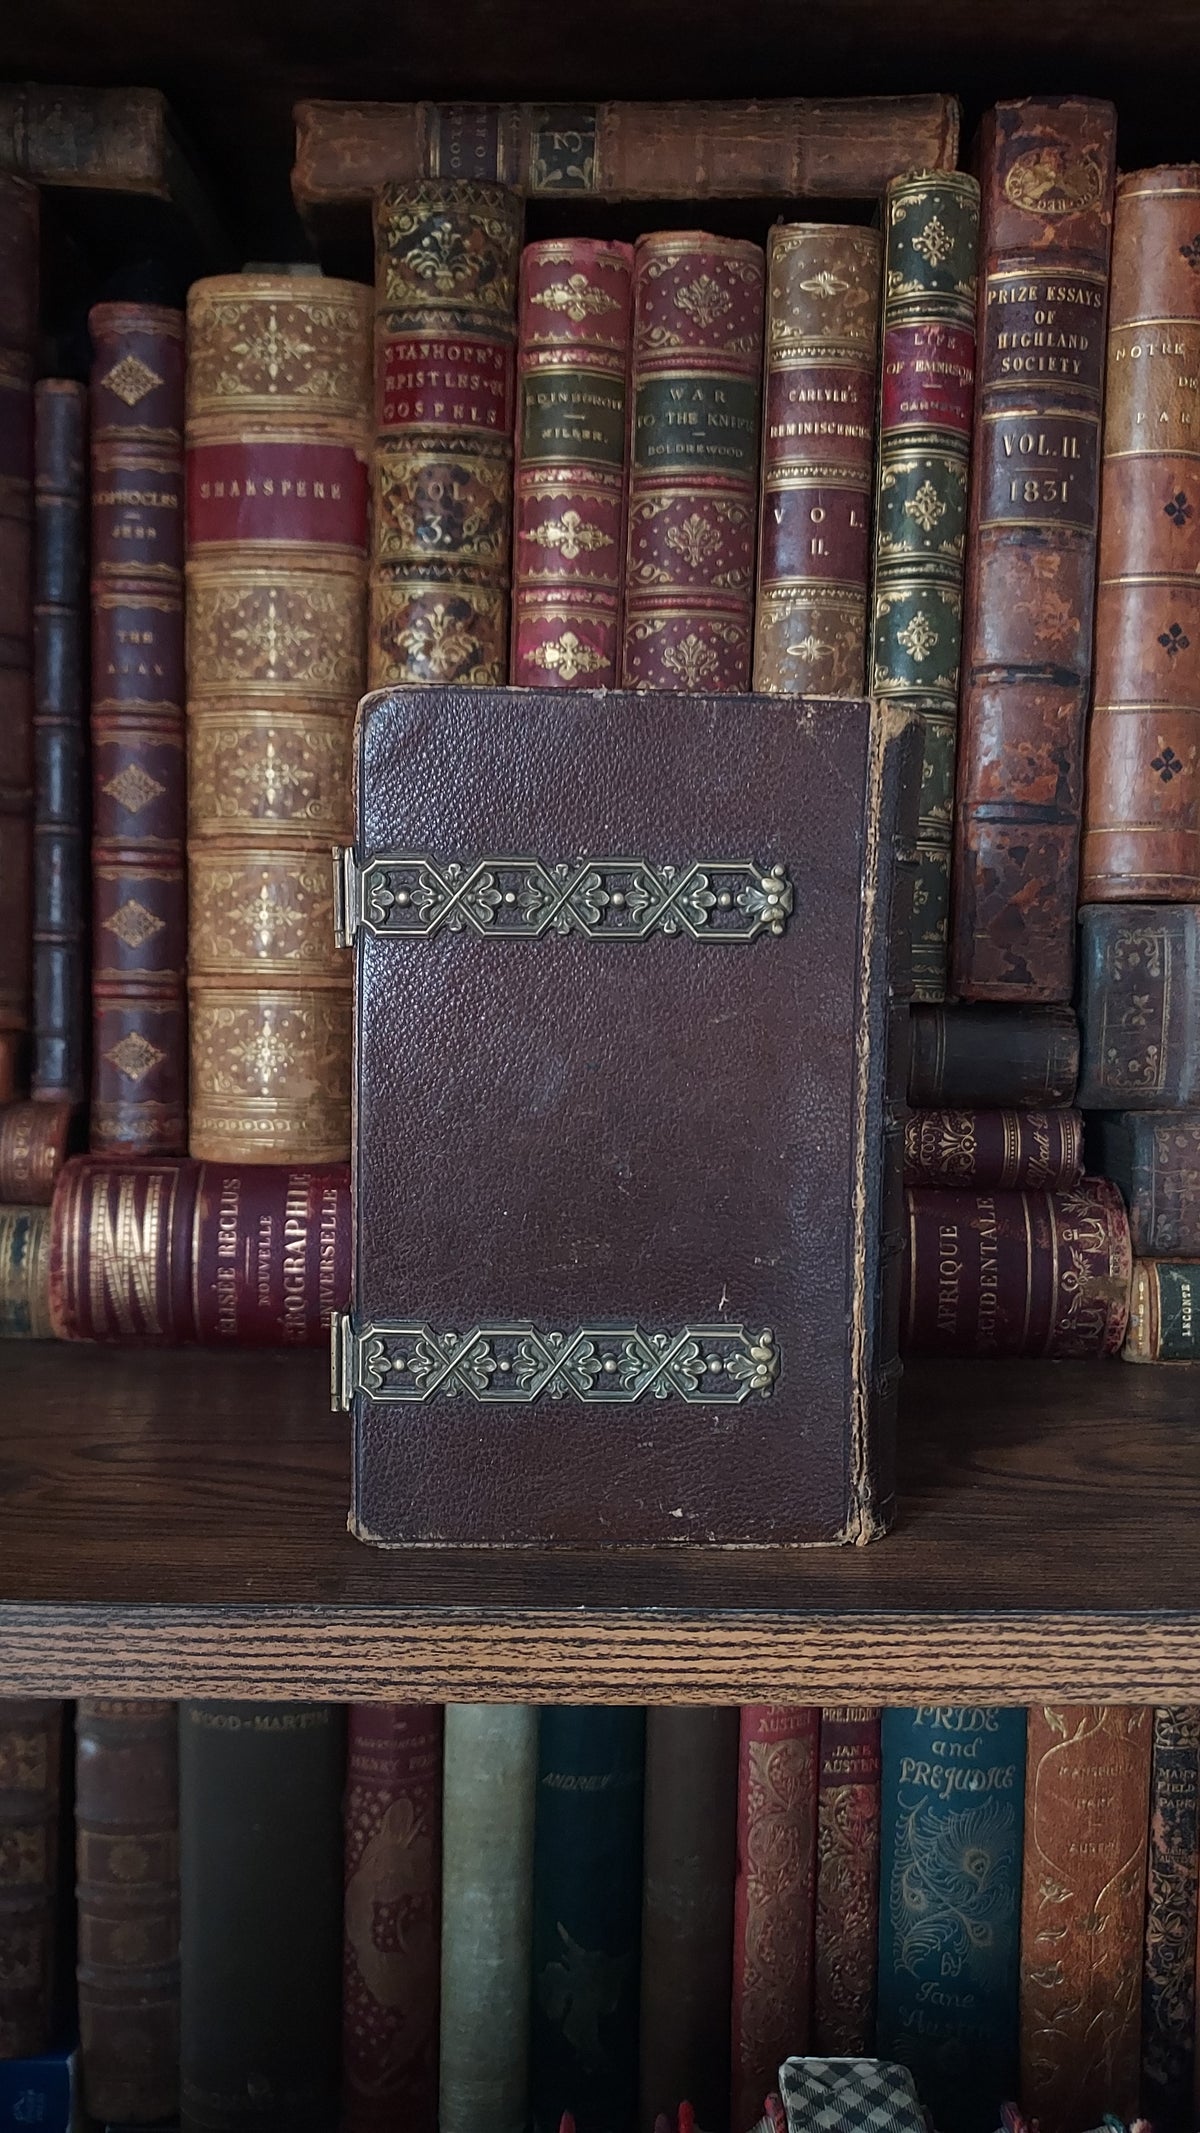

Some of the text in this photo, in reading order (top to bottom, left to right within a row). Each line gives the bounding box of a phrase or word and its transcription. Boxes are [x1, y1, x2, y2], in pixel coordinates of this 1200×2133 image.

[987, 286, 1102, 308] PRIZE ESSAYS
[1034, 310, 1057, 325] OF
[997, 331, 1089, 351] HIGHLAND
[1116, 343, 1185, 360] NOTRE
[886, 361, 905, 374] OF
[1001, 356, 1082, 375] SOCIETY
[669, 388, 727, 404] WAR
[788, 385, 858, 403] CARLYLE'S
[665, 410, 698, 427] THE
[647, 443, 743, 459] BOLDREWOOD
[1010, 479, 1068, 503] 1831
[217, 1178, 241, 1258] RECLUS
[258, 1215, 273, 1306] NOUVELLE
[937, 1224, 963, 1334] AFRIQUE
[912, 1706, 999, 1732] PRIDE
[832, 1745, 872, 1758] JANE
[932, 1737, 982, 1757] and
[899, 1757, 1016, 1800] PREJUDICE
[940, 1952, 961, 1977] by
[915, 1981, 975, 2008] Jane
